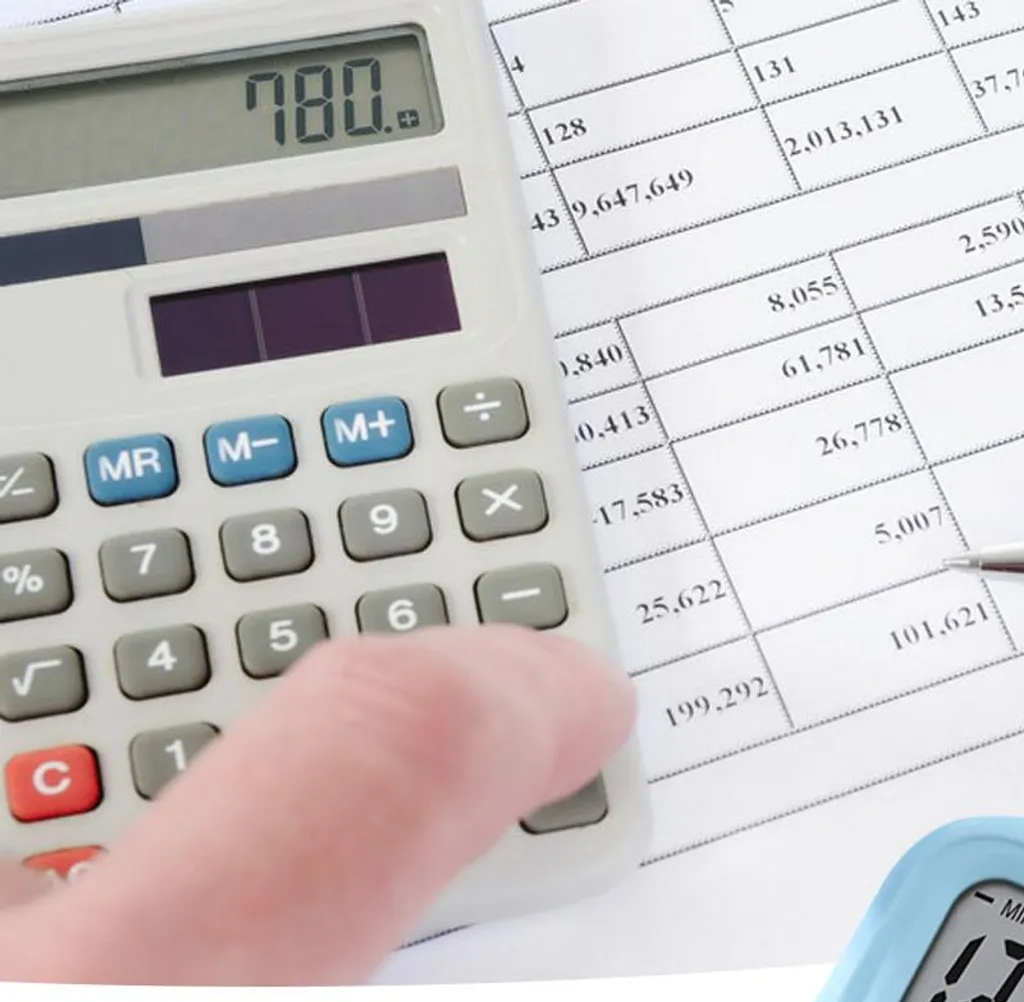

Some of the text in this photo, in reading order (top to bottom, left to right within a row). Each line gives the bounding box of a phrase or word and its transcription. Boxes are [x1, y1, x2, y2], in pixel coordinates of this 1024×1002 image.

[938, 1, 981, 27] 143
[510, 56, 525, 73] 4
[753, 56, 796, 83] 131
[542, 117, 588, 145] 128
[784, 104, 904, 157] 2,013,131
[571, 168, 694, 219] 9,647,649
[766, 275, 838, 312] 8,055
[781, 337, 866, 380] 61,781
[334, 412, 397, 444] M+
[815, 413, 902, 457] 26,778
[97, 447, 162, 483] MR
[369, 503, 399, 535] 9
[874, 505, 945, 546] 5,007
[251, 523, 281, 556] 8
[130, 543, 158, 576] 7
[387, 599, 416, 630] 6
[636, 578, 727, 625] 25,622
[268, 620, 299, 652] 5
[890, 600, 990, 651] 101,621
[147, 641, 178, 672] 4
[665, 675, 769, 728] 199,292
[165, 741, 186, 770] 1
[32, 763, 72, 796] C
